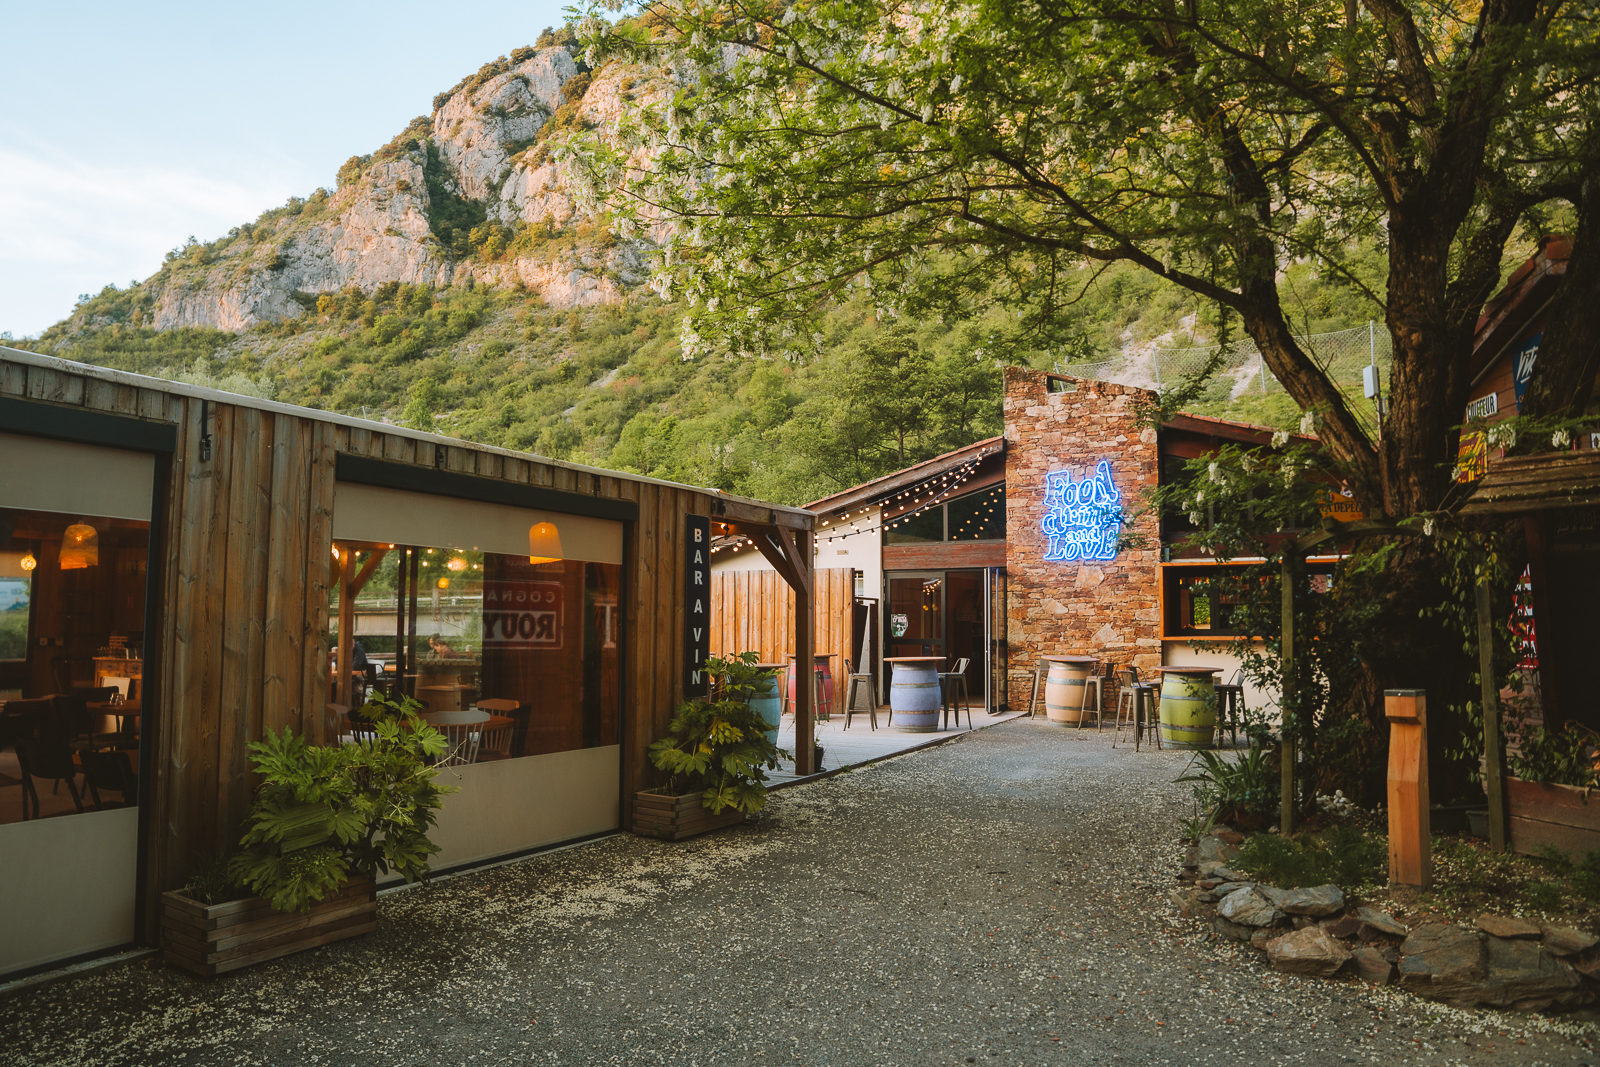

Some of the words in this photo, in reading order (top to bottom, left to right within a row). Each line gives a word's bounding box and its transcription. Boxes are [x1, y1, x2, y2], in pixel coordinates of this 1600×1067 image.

[1467, 395, 1495, 421] COIFFEUR
[1043, 459, 1119, 508] Food
[1041, 503, 1123, 535] drink
[1065, 527, 1102, 541] and
[693, 527, 703, 586] BAR
[693, 598, 703, 614] A
[691, 627, 703, 686] VIN
